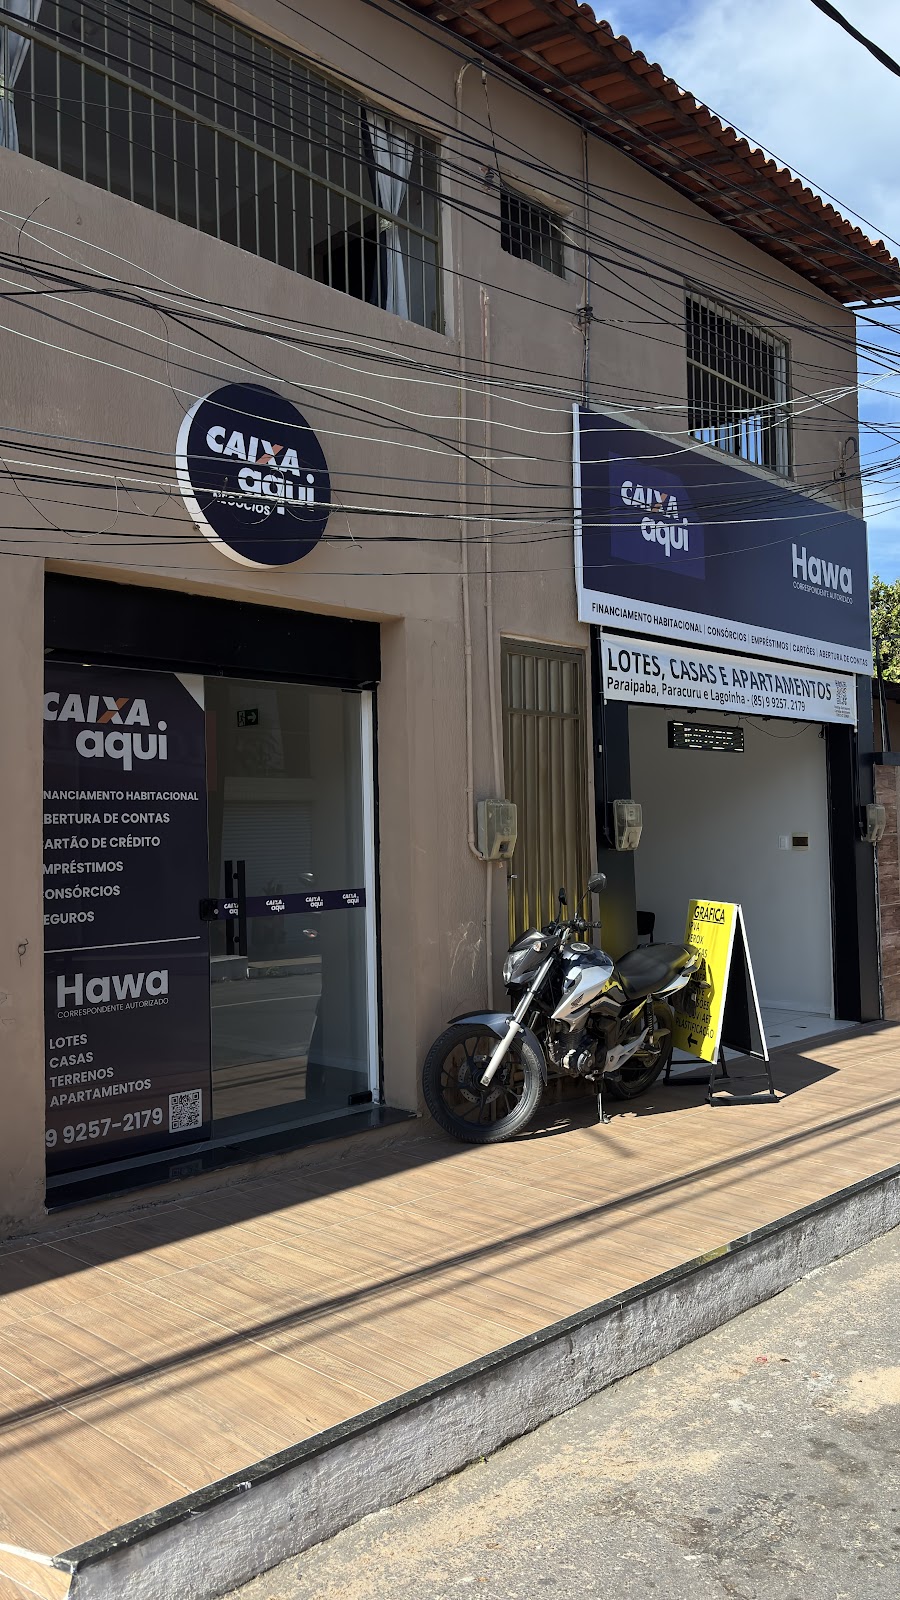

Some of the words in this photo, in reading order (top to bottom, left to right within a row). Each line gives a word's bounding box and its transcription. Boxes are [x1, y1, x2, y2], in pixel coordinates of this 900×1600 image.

[206, 425, 301, 477] CAIXA
[238, 467, 315, 515] aqui
[620, 480, 680, 521] CAIXA
[640, 516, 689, 557] aqui
[791, 543, 853, 595] Hawa
[591, 602, 652, 624] FINANCIAMENTO
[653, 615, 702, 634] HABITACIONAL
[707, 626, 747, 642] CONSÓRCIOS
[751, 635, 789, 651] EMPRÉSTIMOS
[792, 644, 816, 656] CARTÕES
[607, 647, 665, 681] LOTES,
[669, 658, 717, 685] CASAS
[718, 666, 729, 686] E
[731, 668, 832, 701] APARTAMENTOS
[607, 676, 659, 697] Paraipaba,
[661, 682, 702, 699] Paracuru
[703, 690, 709, 700] e
[710, 688, 746, 705] Lagoinha
[751, 694, 765, 709] (85)
[43, 692, 150, 727] CAIXA
[75, 720, 168, 771] aqui
[43, 790, 124, 800] NANCIAMENTO
[126, 791, 199, 801] HABITACIONAL
[43, 813, 101, 825] BERTURA
[103, 813, 119, 824] DE
[121, 812, 171, 824] CONTAS
[43, 835, 89, 850] ARTÃO
[91, 837, 107, 849] DE
[109, 834, 161, 848] CRÉDITO
[43, 859, 124, 875] MPRÉSTIMOS
[43, 884, 121, 900] ONSÓRCIOS
[43, 910, 95, 926] EGUROS
[694, 902, 726, 923] GRÁFICA
[57, 969, 169, 1008] Hawa
[57, 1003, 124, 1019] CORRESPONDENTE
[125, 997, 169, 1010] AUTORIZADO
[50, 1033, 88, 1049] LOTES
[50, 1051, 94, 1068] CASAS
[50, 1067, 114, 1088] TERRENOS
[50, 1078, 152, 1107] APARTAMENTOS
[45, 1128, 58, 1148] 9
[63, 1107, 164, 1144] 9257-2179
